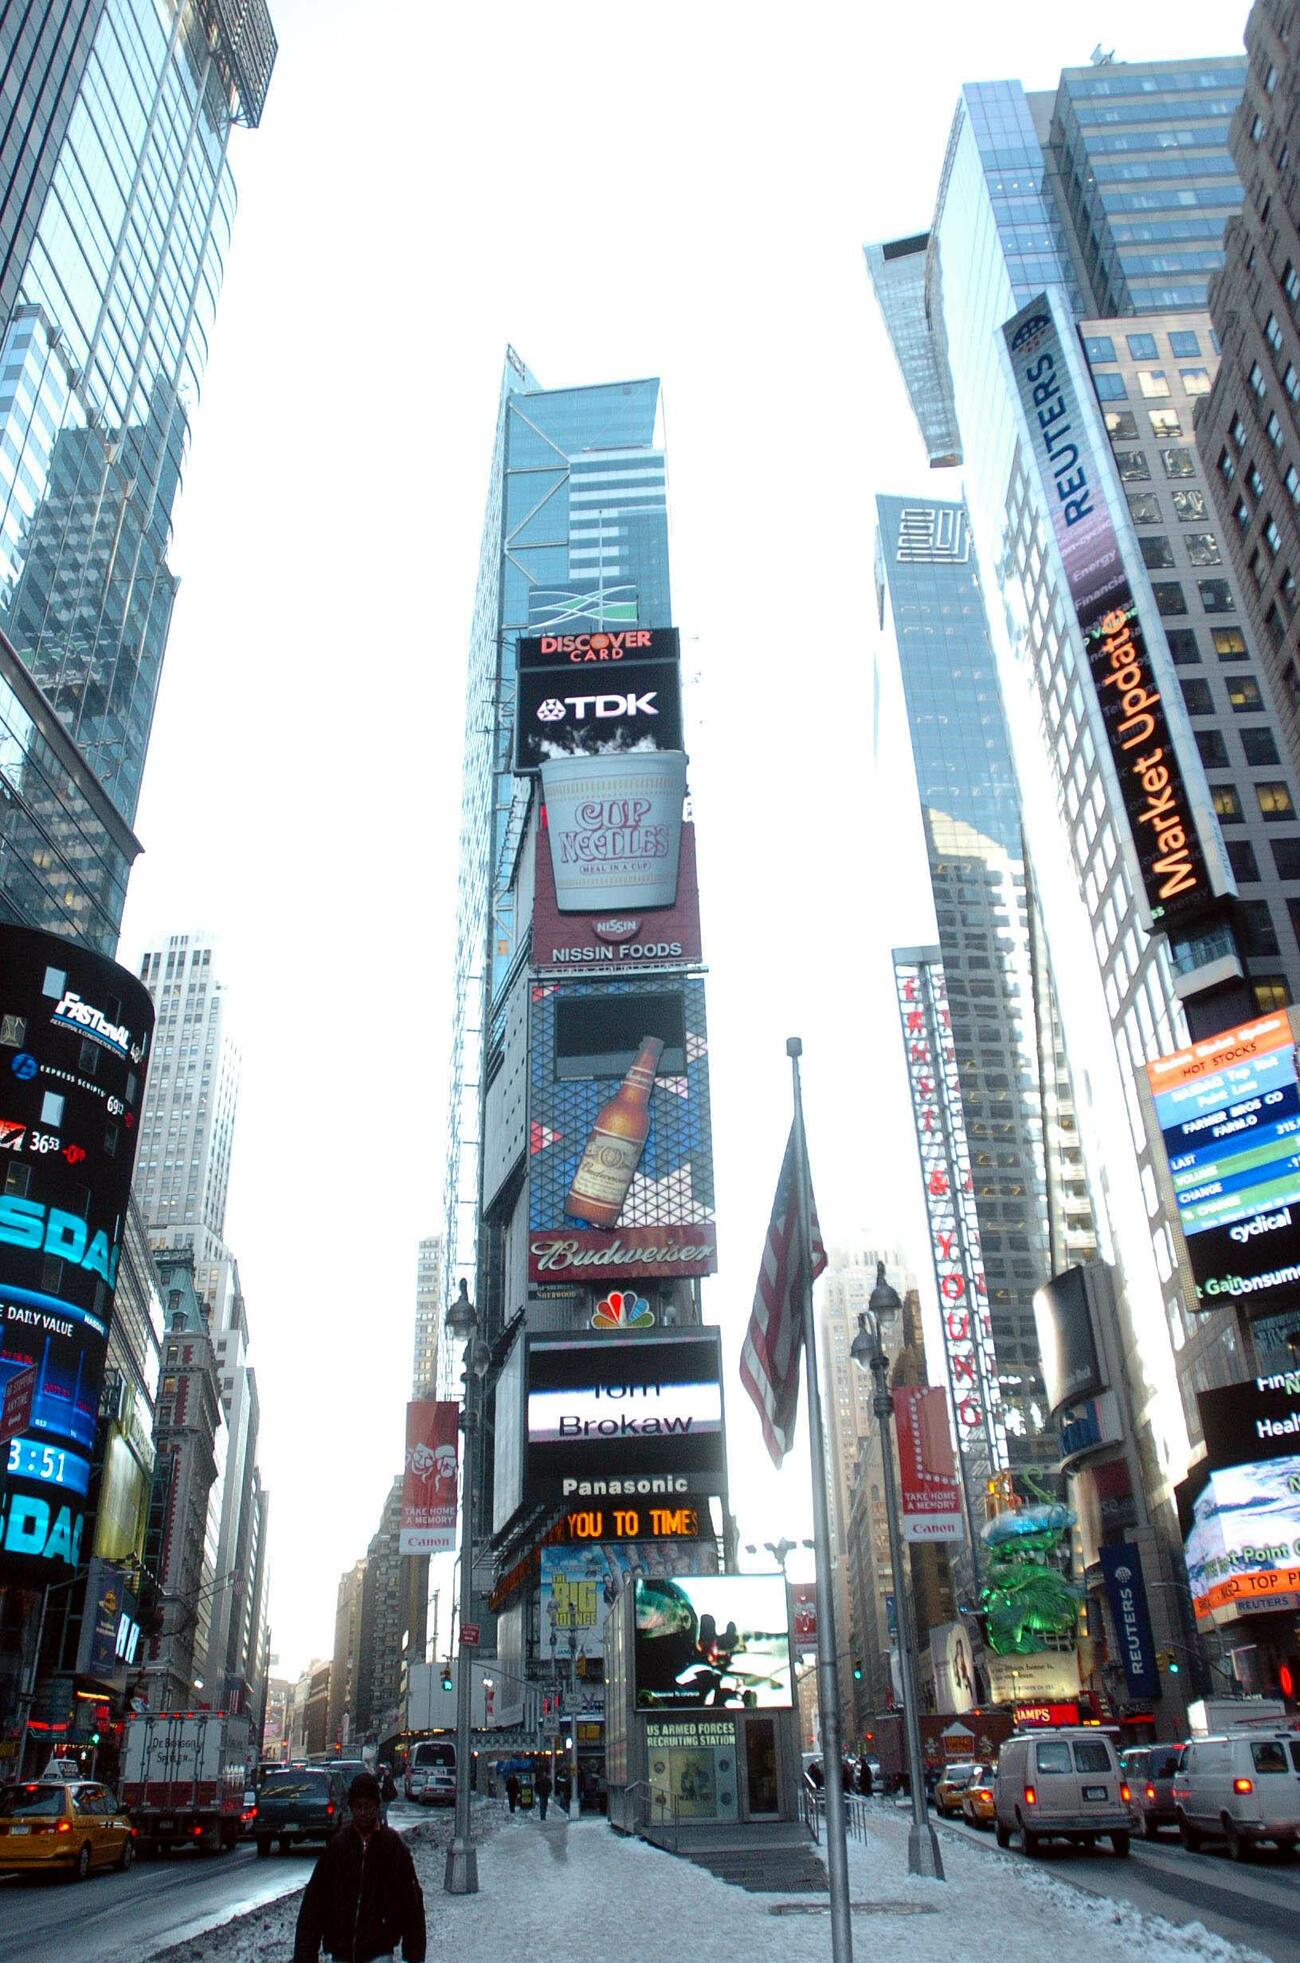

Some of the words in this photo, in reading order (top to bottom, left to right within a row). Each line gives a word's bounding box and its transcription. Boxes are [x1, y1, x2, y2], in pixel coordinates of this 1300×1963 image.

[1027, 353, 1094, 528] REUTERS
[1072, 549, 1116, 582] Energy
[541, 631, 653, 655] DISCOVER
[570, 648, 624, 663] CARD
[1105, 609, 1160, 750] Update
[564, 691, 659, 719] TDK
[575, 798, 651, 831] CUP
[1133, 747, 1197, 899] Market
[558, 823, 672, 863] NOODLES
[597, 919, 636, 933] NISSIN
[552, 946, 613, 963] NISSIN
[619, 943, 682, 959] FOODS
[1182, 1062, 1206, 1078] HOT
[1213, 1041, 1257, 1067] STOCKS
[40, 1064, 75, 1083] EXPRESS
[77, 1077, 105, 1098] SCRIPTS
[1182, 1111, 1228, 1135] FARMER
[1264, 1090, 1284, 1105] CO
[1171, 1155, 1196, 1170] LAST
[1178, 1182, 1223, 1204] CHANGE
[1230, 1207, 1292, 1243] cyclical
[531, 1239, 715, 1271] Budweiser
[1205, 1274, 1243, 1295] Gain
[7, 1305, 41, 1326] DAILY
[42, 1314, 74, 1337] VALUE
[937, 1230, 982, 1427] YOUNG
[559, 1415, 692, 1437] Brokaw
[1256, 1412, 1300, 1438] Heal
[7, 1439, 66, 1482] 3:51
[563, 1475, 688, 1496] Panasonic
[904, 1493, 929, 1501] TAKE
[931, 1492, 956, 1500] HOME
[405, 1508, 428, 1517] TAKE
[430, 1507, 456, 1515] HOME
[908, 1502, 915, 1510] A
[917, 1501, 955, 1510] MEMORY
[406, 1516, 413, 1525] A
[415, 1515, 453, 1525] MEMORY
[568, 1512, 603, 1538] YOU
[613, 1511, 639, 1537] TO
[912, 1523, 955, 1534] Canon
[408, 1536, 450, 1548] Canon
[1241, 1544, 1289, 1565] Point
[1248, 1574, 1278, 1590] TOP
[553, 1582, 597, 1613] BIG
[1238, 1596, 1289, 1610] REUTERS
[1120, 1588, 1144, 1675] REUTERS
[647, 1725, 660, 1736] US
[662, 1724, 696, 1736] ARMED
[698, 1722, 735, 1735] FORCES
[647, 1736, 698, 1747] RECRUITING
[700, 1735, 736, 1746] STATION
